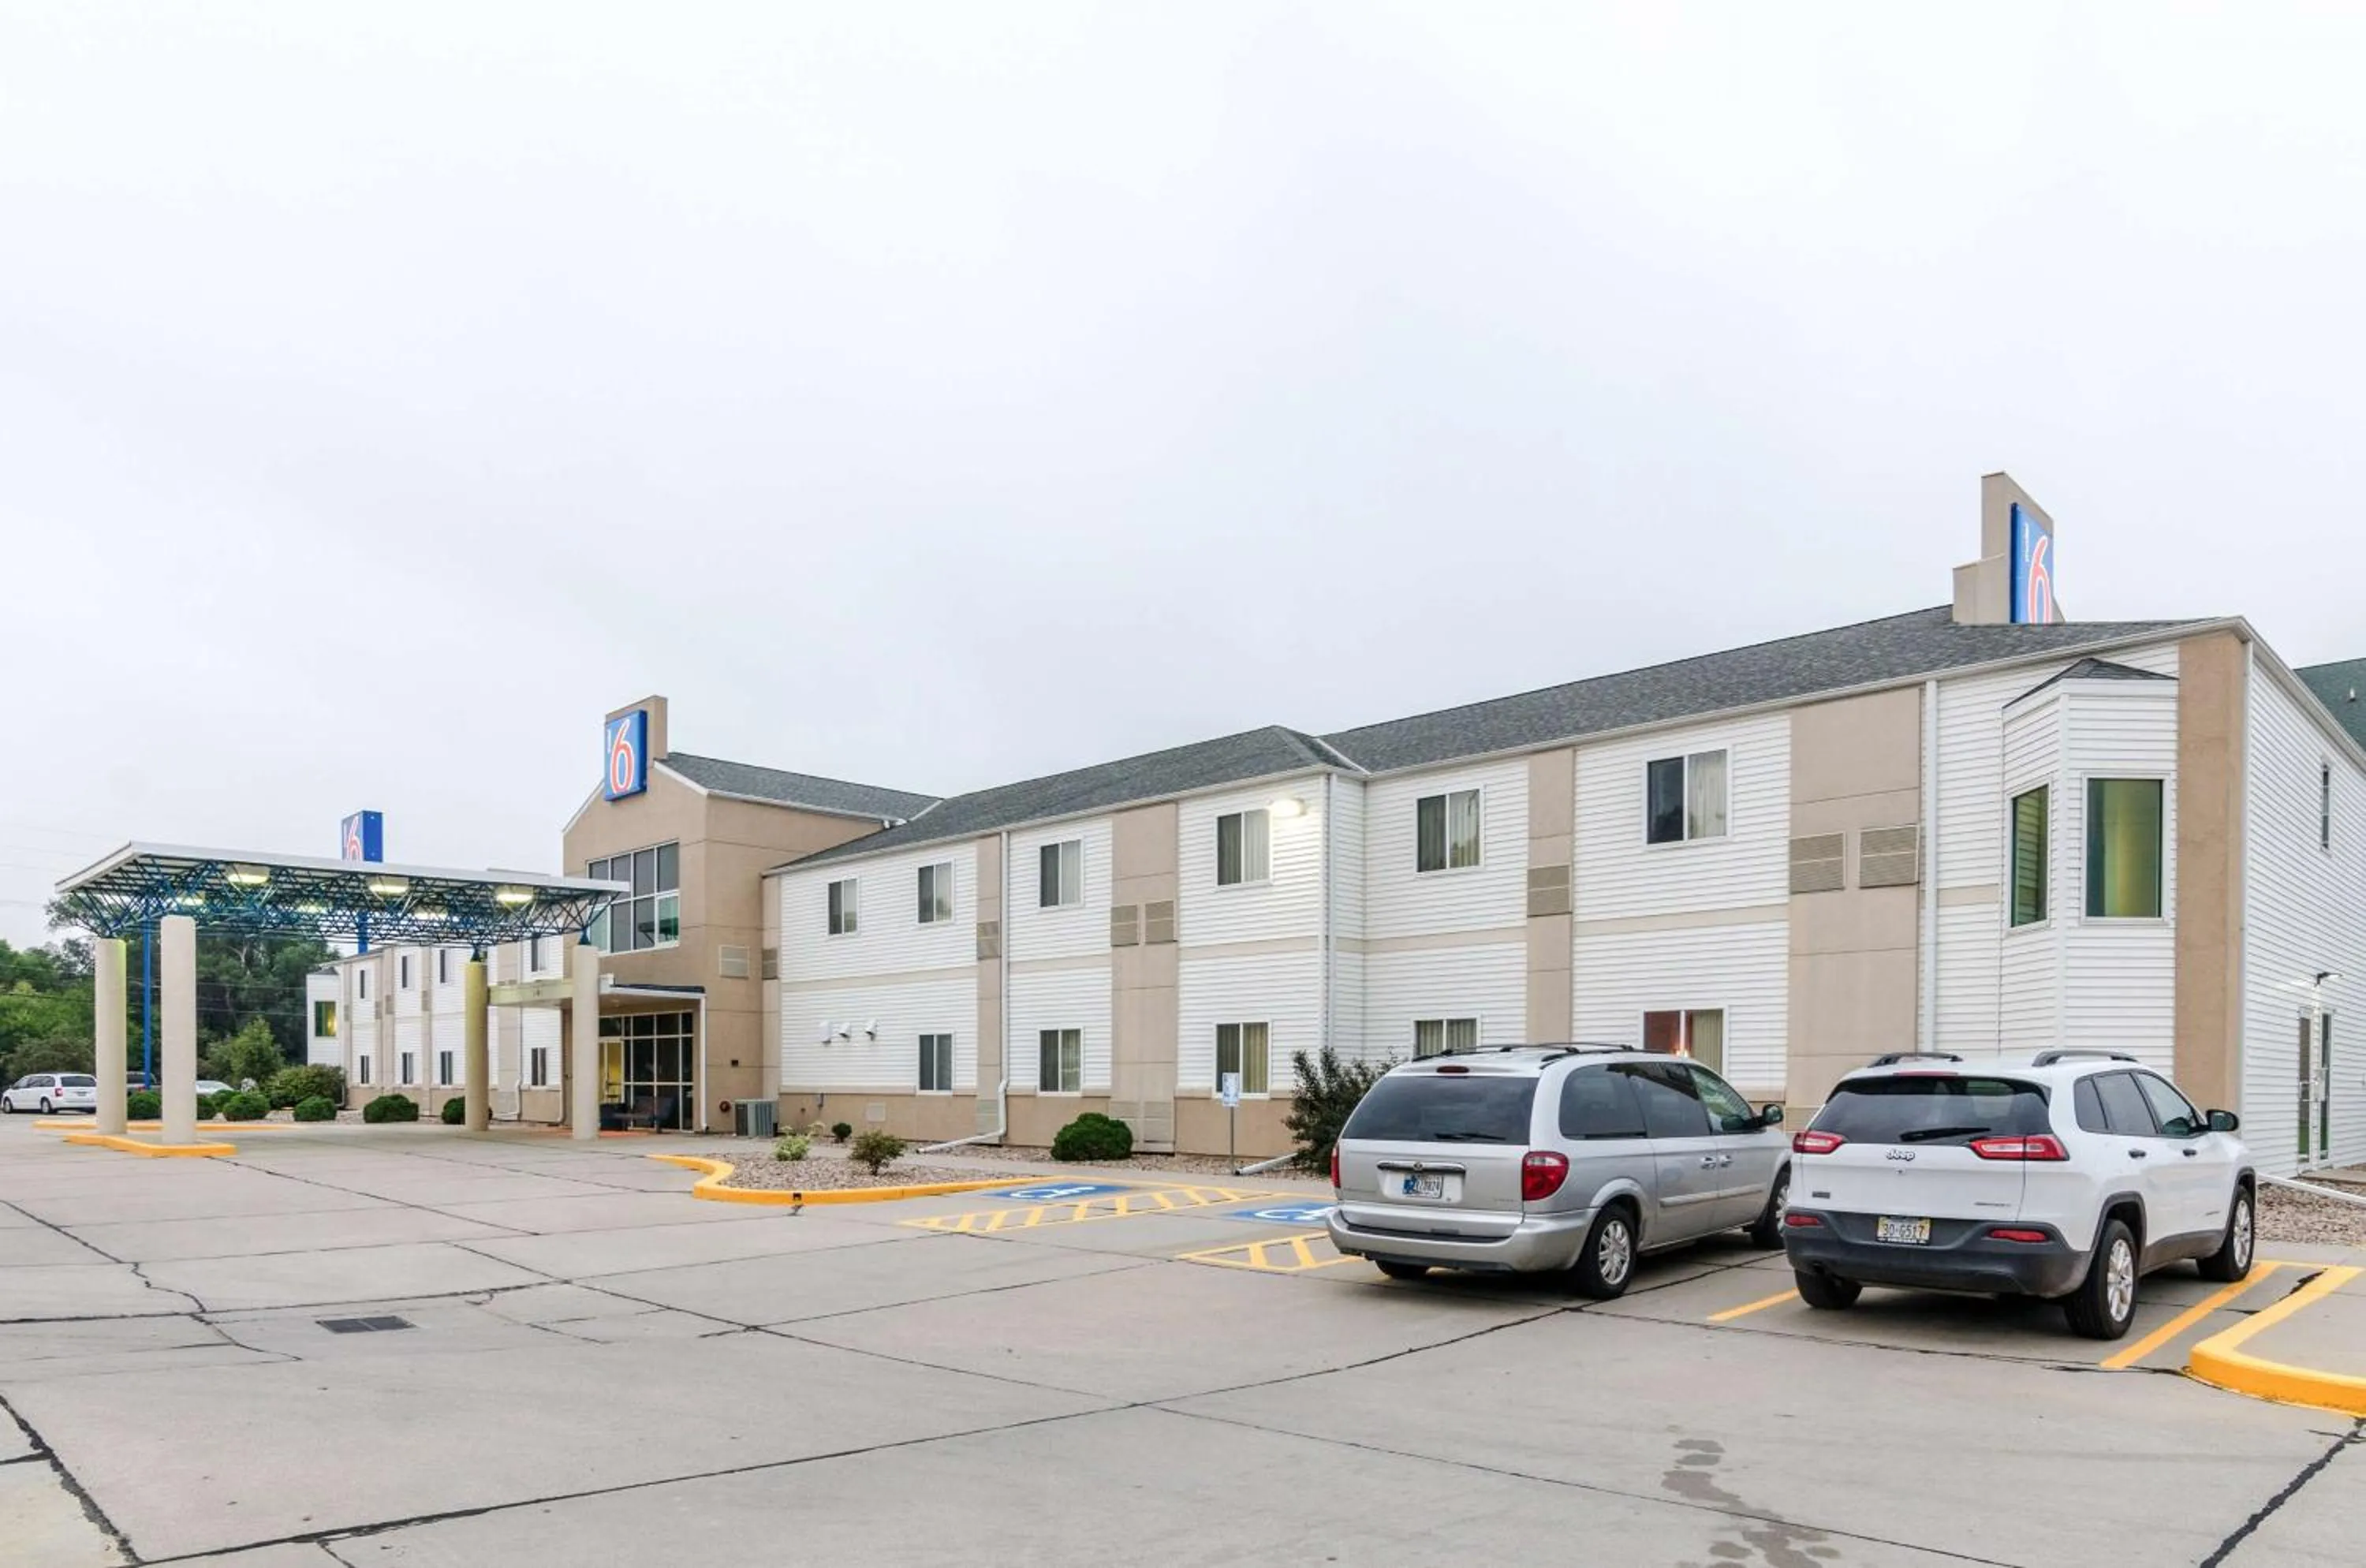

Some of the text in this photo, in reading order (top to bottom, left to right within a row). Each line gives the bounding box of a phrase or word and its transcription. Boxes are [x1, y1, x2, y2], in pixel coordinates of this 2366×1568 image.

[2028, 535, 2051, 625] 6
[610, 719, 634, 794] 6
[1886, 1148, 1916, 1162] Jeep
